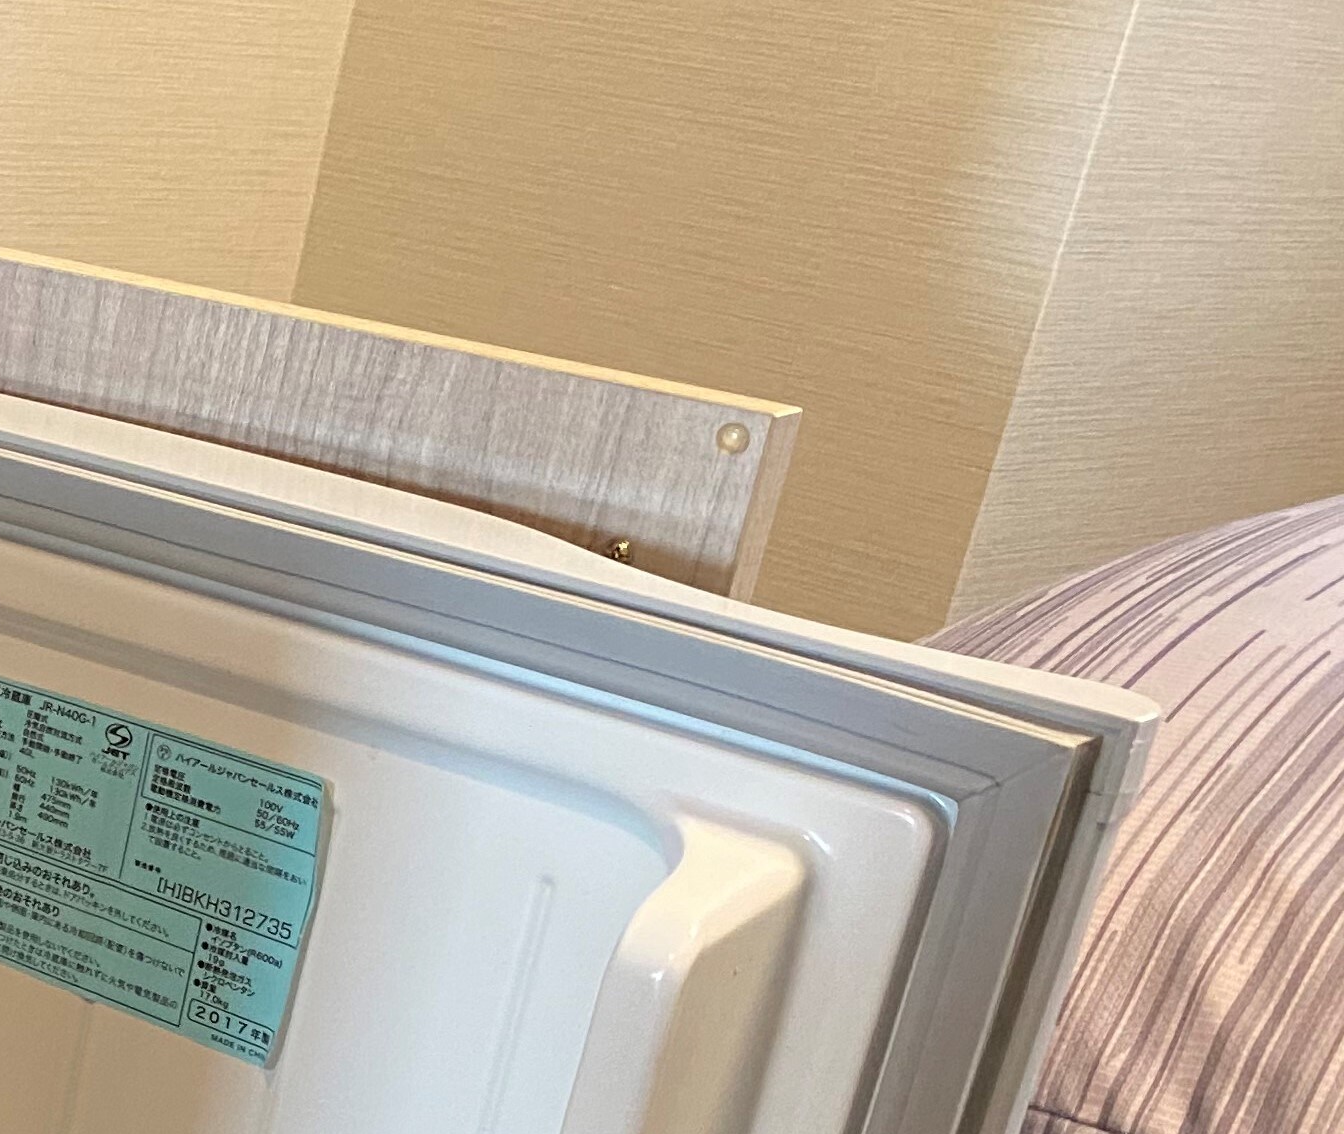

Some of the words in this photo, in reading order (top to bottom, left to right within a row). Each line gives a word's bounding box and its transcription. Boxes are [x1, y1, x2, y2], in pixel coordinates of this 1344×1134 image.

[40, 700, 95, 726] JR-N40G-1
[156, 876, 293, 940] [H]BKH312735
[211, 1033, 234, 1048] MADE
